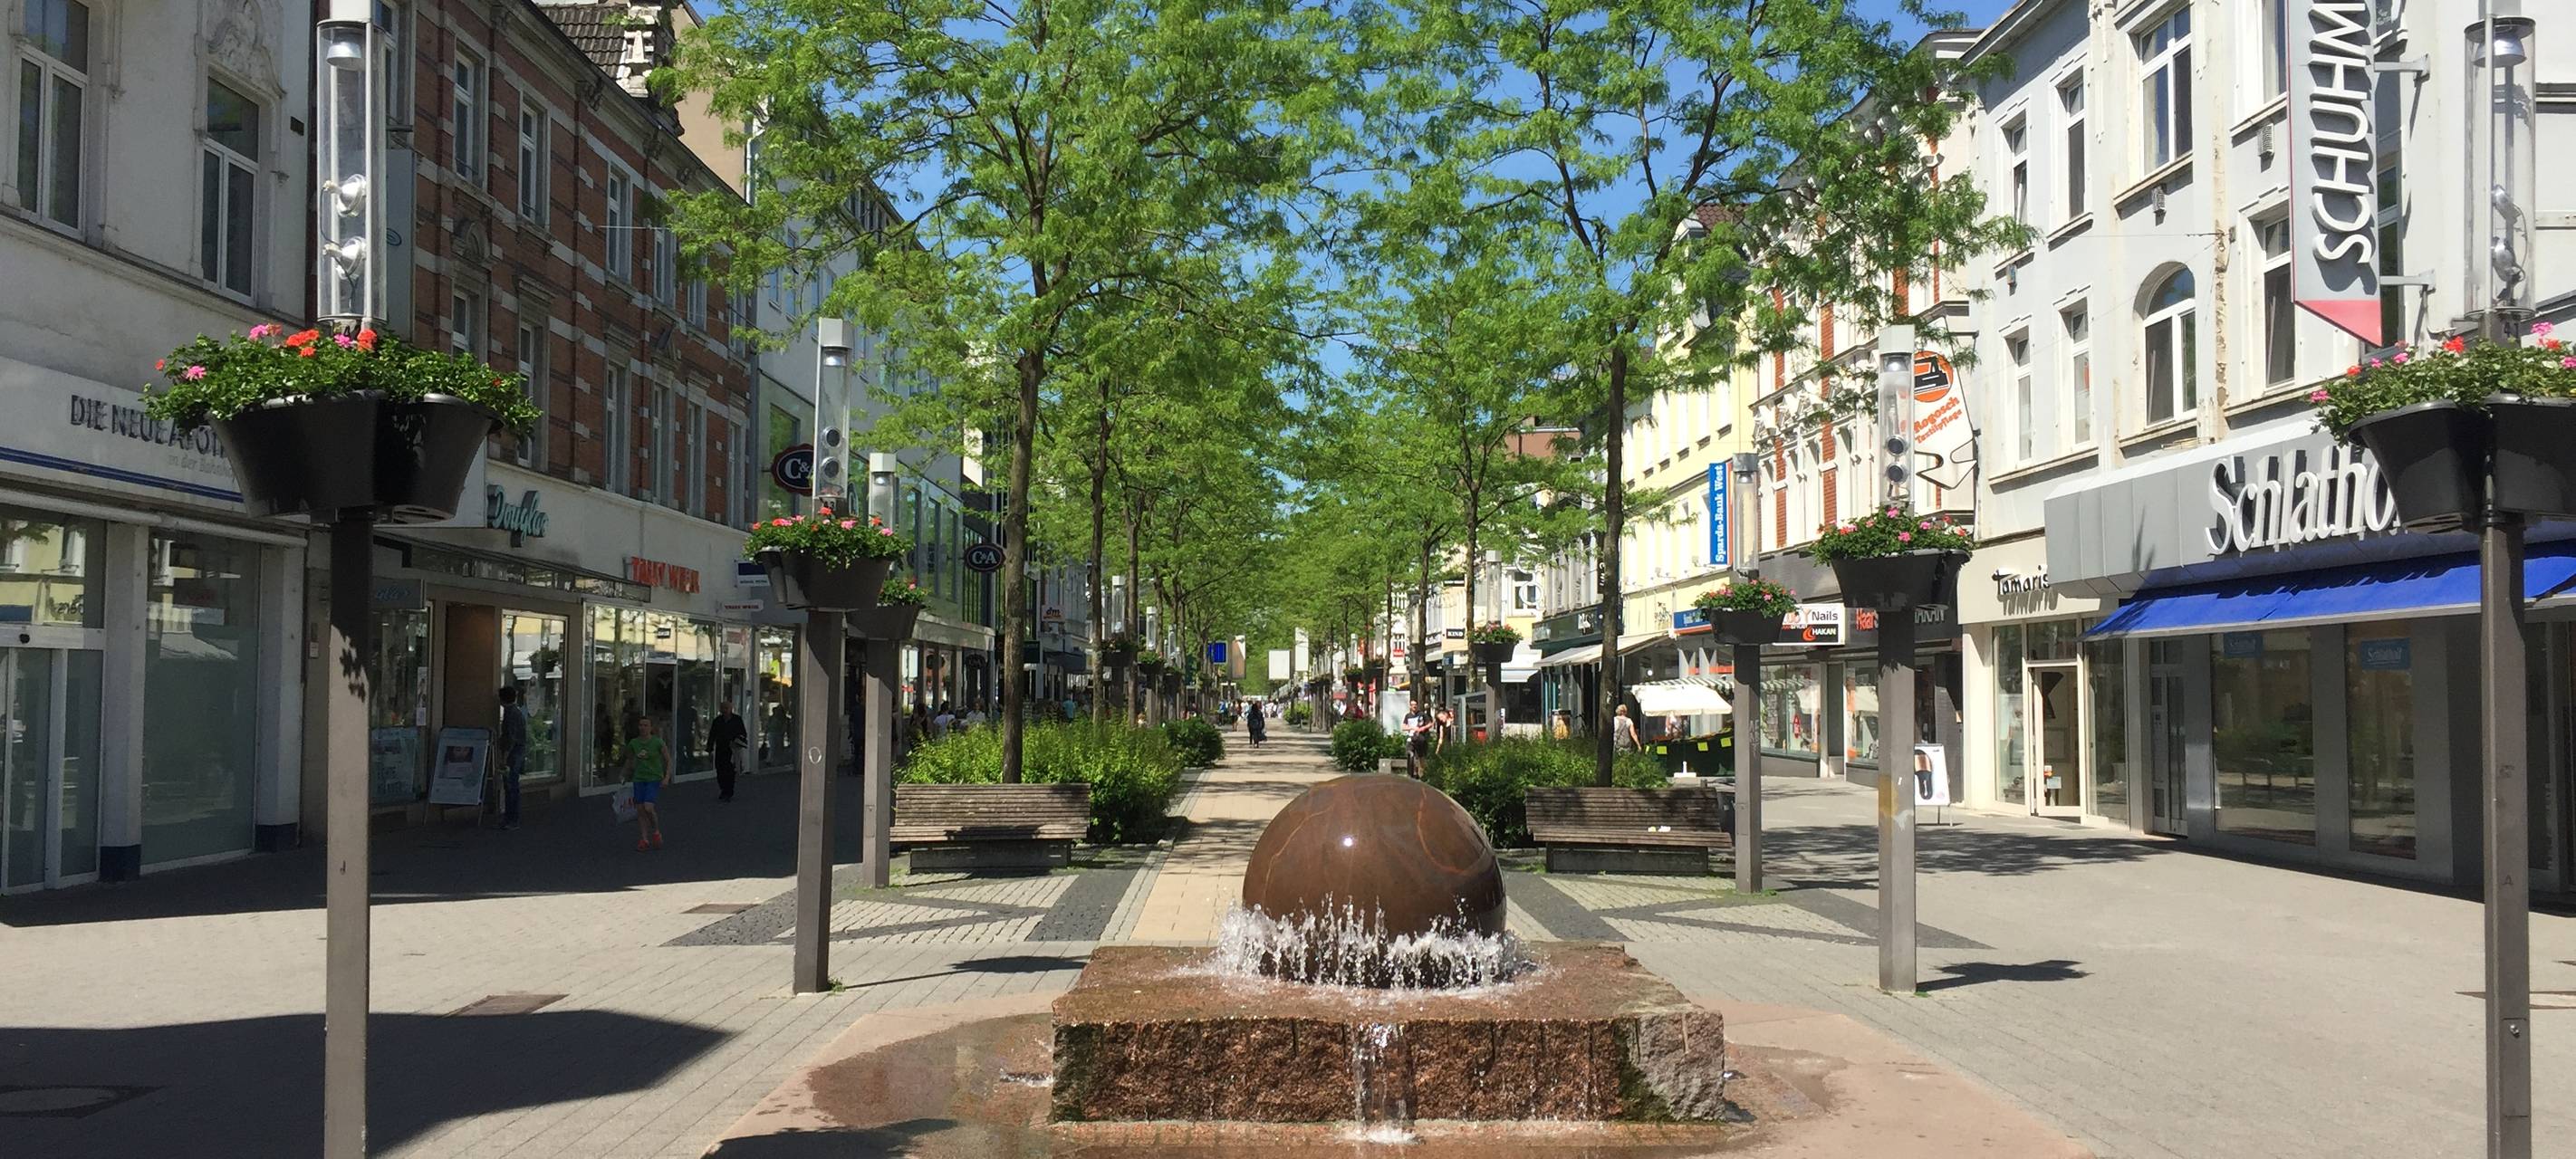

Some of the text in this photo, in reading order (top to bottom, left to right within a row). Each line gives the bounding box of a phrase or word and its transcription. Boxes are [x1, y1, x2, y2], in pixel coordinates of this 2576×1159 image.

[70, 394, 108, 430] DIE
[111, 404, 168, 445] NEUE
[1913, 397, 1960, 434] Rogosch
[1915, 409, 1962, 444] Textilpflege
[784, 458, 814, 479] C&
[1715, 465, 1725, 562] Sparda-Bank West
[2205, 444, 2400, 555] Schlatho
[972, 551, 997, 564] C&A
[1992, 565, 2050, 595] Tamaris
[1046, 607, 1061, 616] dm
[1812, 611, 1839, 621] Nails
[1812, 627, 1837, 636] HAKAN
